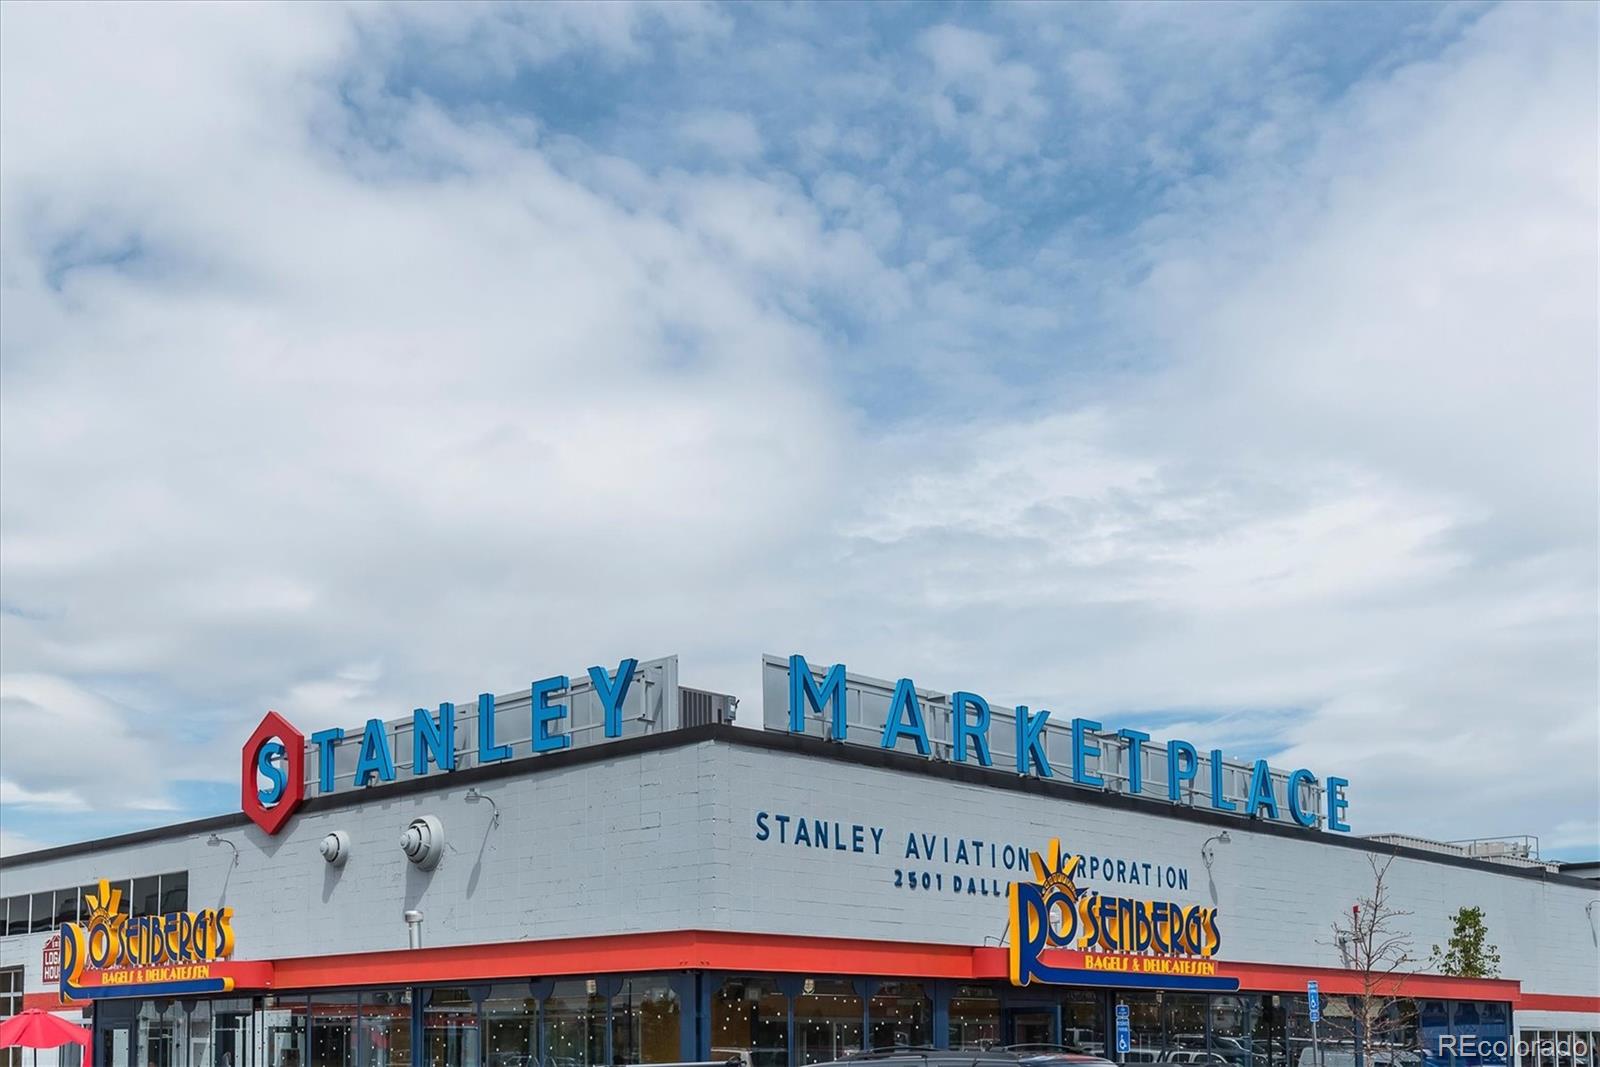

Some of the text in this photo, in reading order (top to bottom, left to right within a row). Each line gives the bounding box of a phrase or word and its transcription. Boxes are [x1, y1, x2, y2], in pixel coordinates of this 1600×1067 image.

[257, 658, 638, 804] STANLEY
[789, 654, 1350, 832] MARKETPLACE
[756, 811, 883, 854] STANLEY
[905, 832, 1029, 872] AVIATION
[1061, 852, 1189, 891] ORPORATION
[894, 869, 942, 891] 2501
[44, 951, 60, 965] LOG
[59, 906, 235, 1003] ROSENBERG'S
[1009, 882, 1223, 988] ROSENBERG'S
[44, 966, 60, 980] HOU
[102, 965, 209, 984] BAGELS & DELICATESSEN
[1084, 954, 1215, 975] BAGELS & DELICATESSEN
